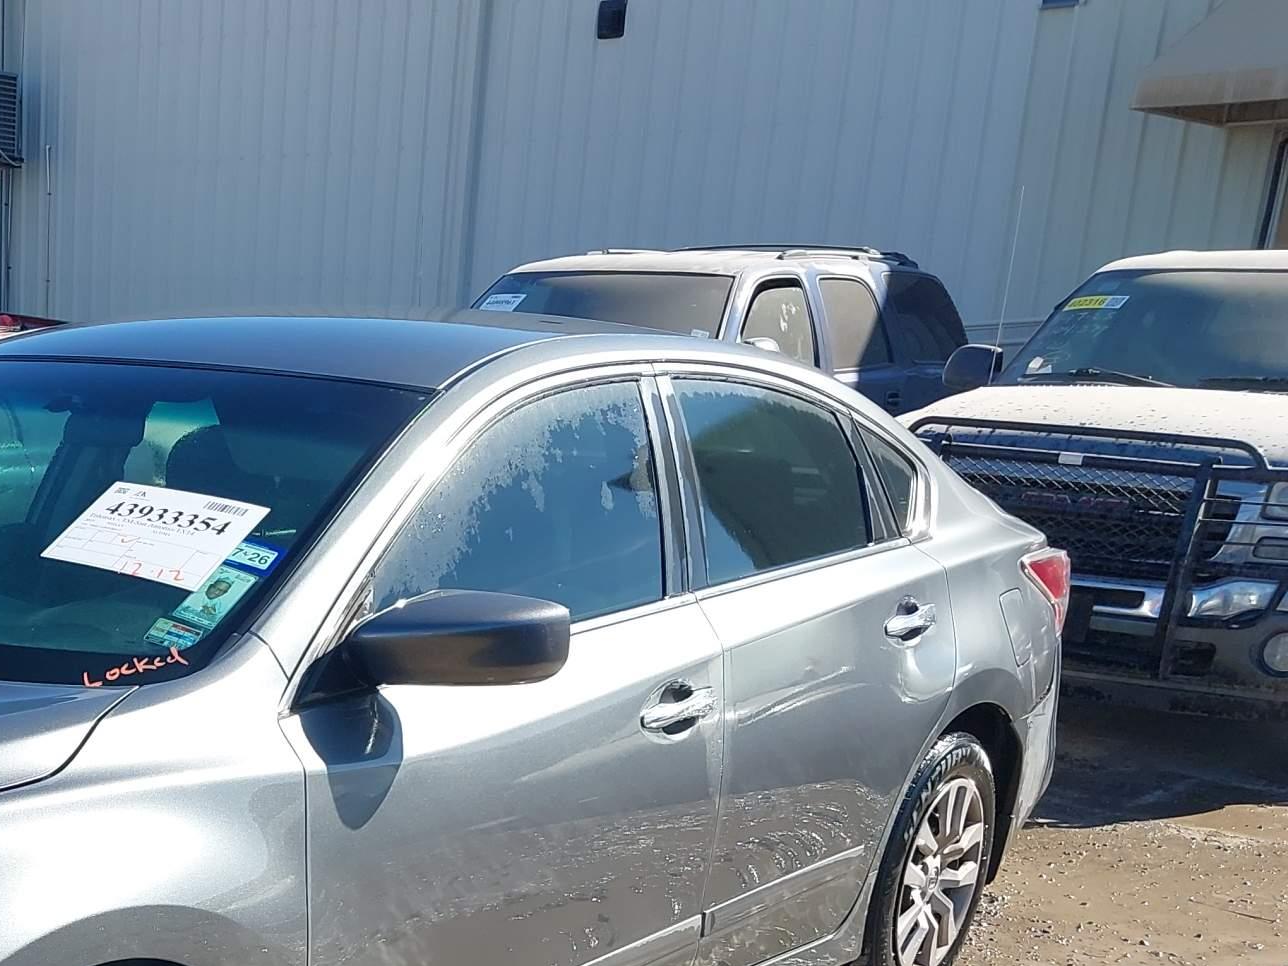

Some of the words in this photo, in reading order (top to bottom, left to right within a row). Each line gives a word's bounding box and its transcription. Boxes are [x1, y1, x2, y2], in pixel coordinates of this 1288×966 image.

[105, 501, 232, 536] 43933354
[247, 552, 271, 565] 26
[82, 645, 190, 688] Locked
